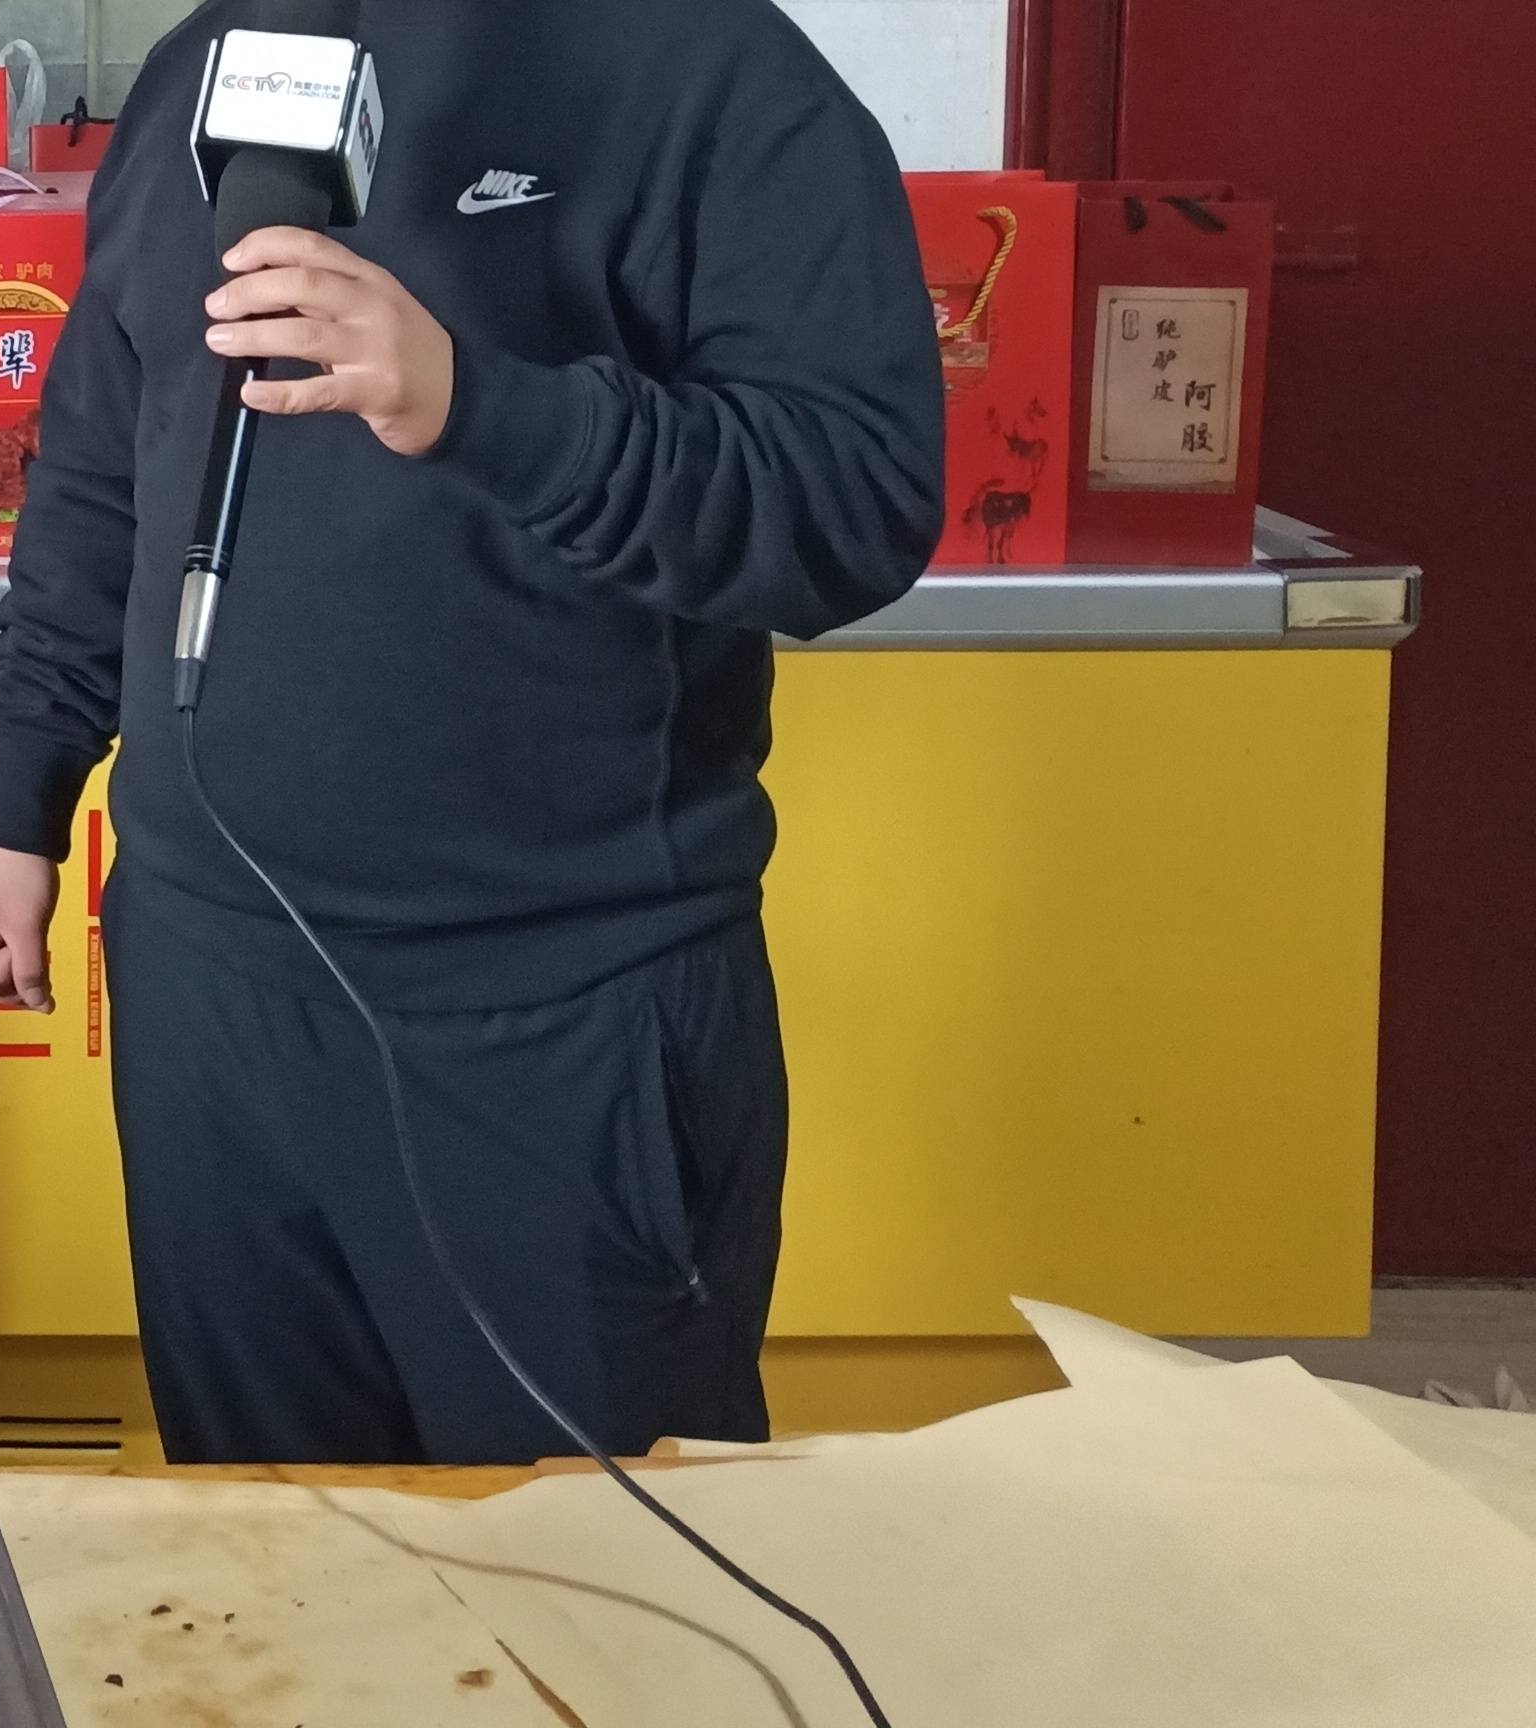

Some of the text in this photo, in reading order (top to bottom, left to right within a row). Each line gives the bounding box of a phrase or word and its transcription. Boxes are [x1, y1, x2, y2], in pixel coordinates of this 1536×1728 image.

[222, 73, 287, 93] CCTV
[474, 169, 539, 198] NIKE
[15, 261, 54, 280] 驴肉
[1181, 379, 1217, 453] 阿胶
